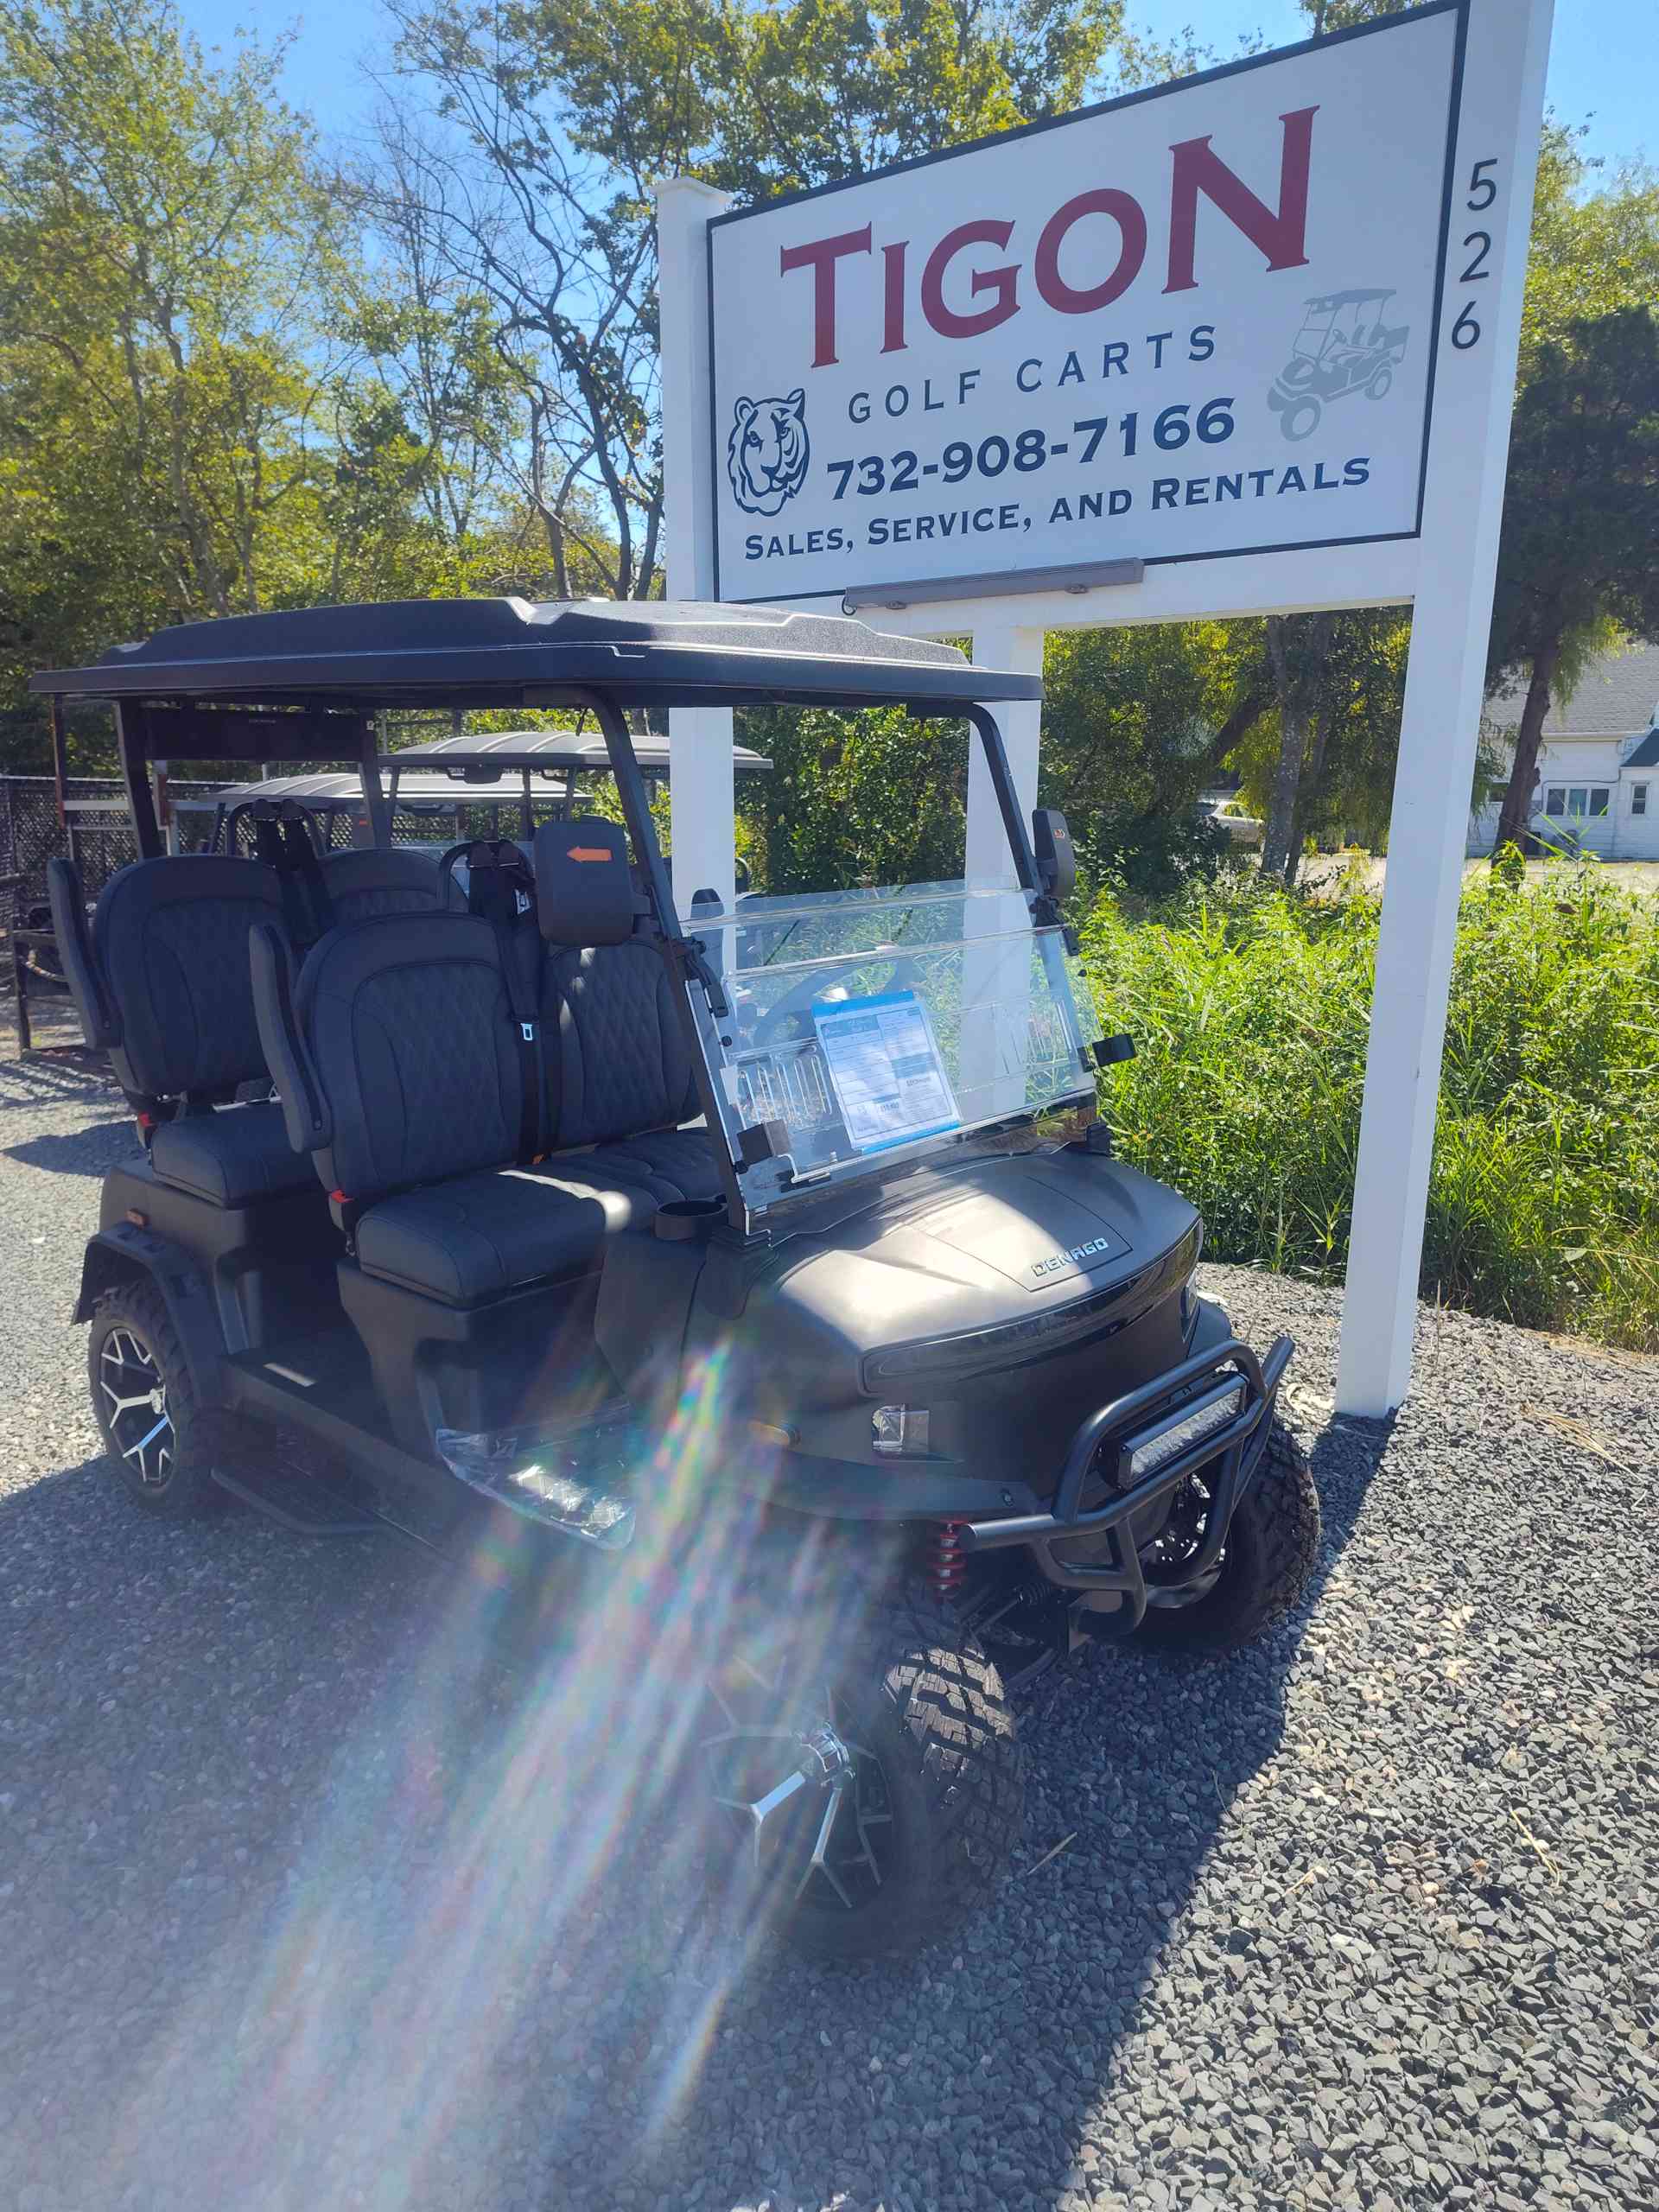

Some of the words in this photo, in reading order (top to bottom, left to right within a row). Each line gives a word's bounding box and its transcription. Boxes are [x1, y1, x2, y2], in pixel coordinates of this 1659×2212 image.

[780, 105, 1320, 368] TIGON
[849, 370, 981, 423] GOLF
[1017, 326, 1215, 392] CARTS
[828, 397, 1236, 500] 732-908-7166
[746, 529, 853, 560] SALES,
[868, 504, 1031, 544] SERVICE,
[1049, 490, 1131, 523] AND
[1152, 458, 1370, 510] RENTALS
[1031, 1237, 1109, 1276] DENAGO
